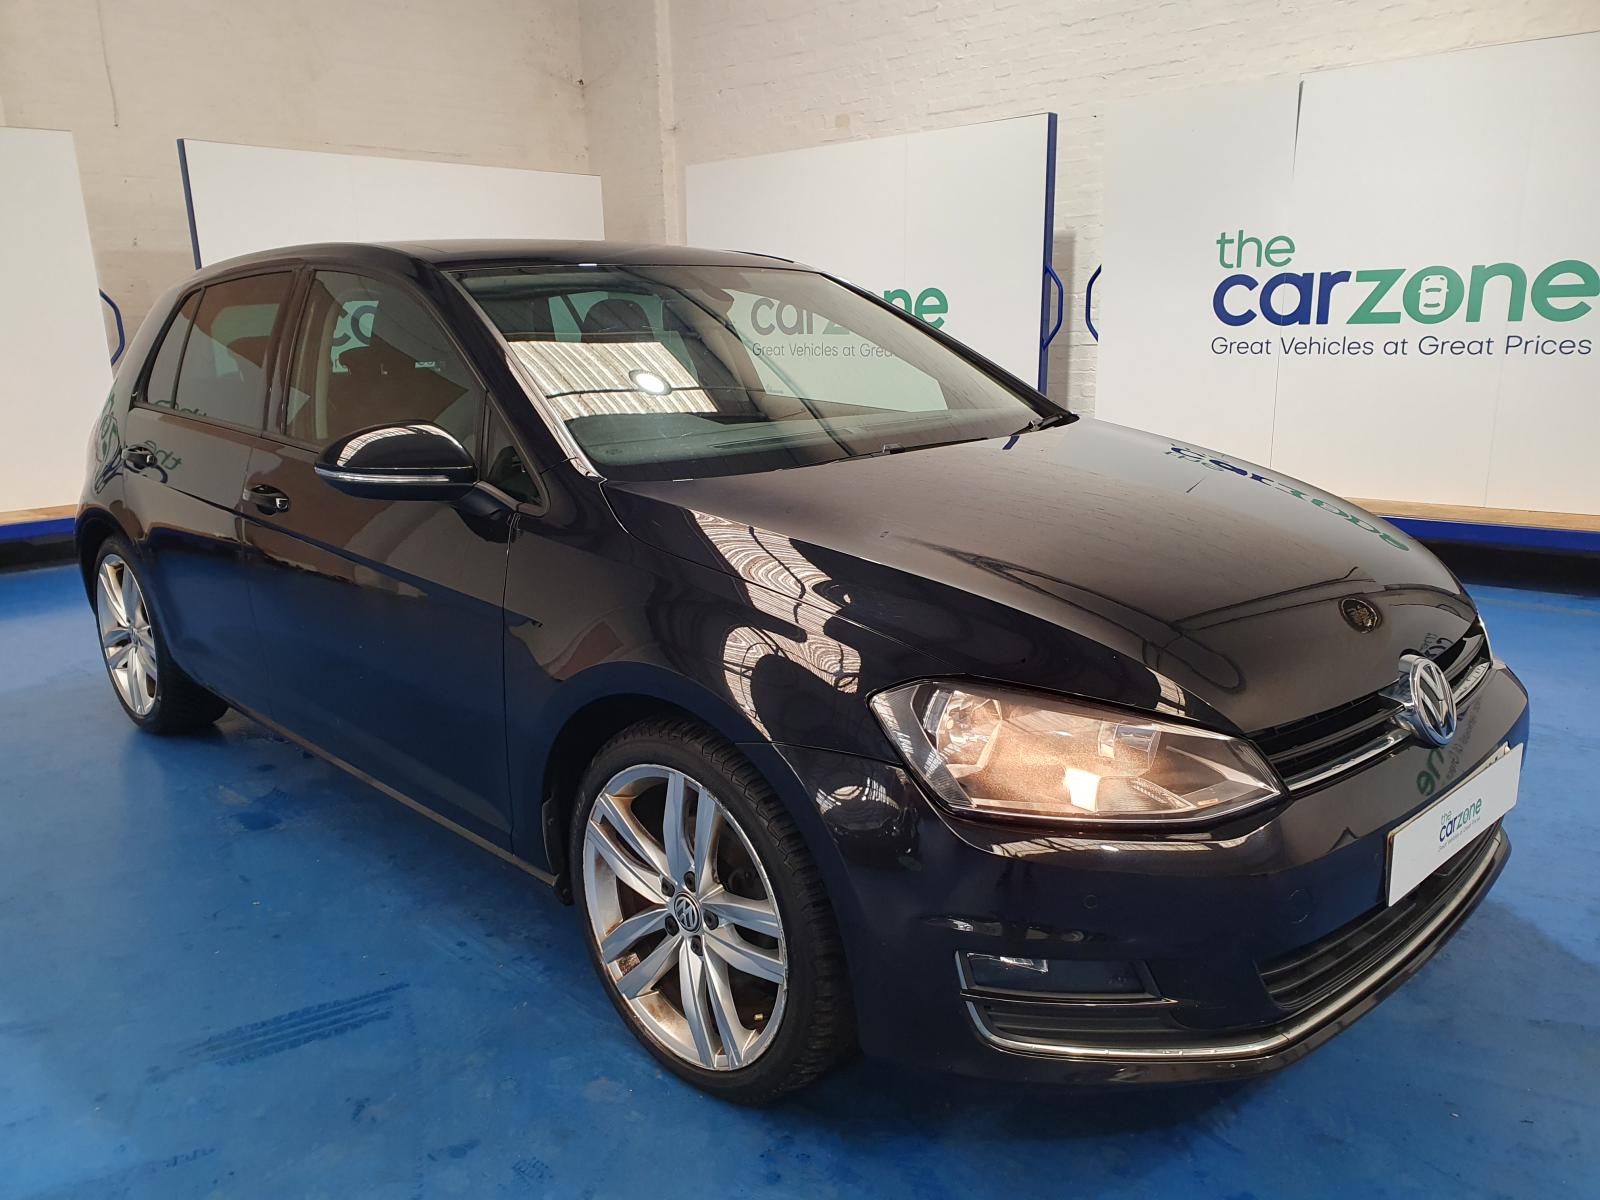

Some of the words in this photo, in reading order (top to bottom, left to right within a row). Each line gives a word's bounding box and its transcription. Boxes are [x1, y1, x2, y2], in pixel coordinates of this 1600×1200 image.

[1216, 230, 1296, 269] the
[1212, 260, 1600, 327] carzone
[752, 342, 785, 357] Great
[789, 342, 839, 358] Vehicles
[842, 344, 858, 358] at
[859, 343, 897, 359] Grea
[1211, 337, 1272, 356] Great
[1280, 336, 1375, 356] Vehicles
[1383, 337, 1408, 356] at
[1418, 335, 1495, 356] Great
[1504, 334, 1593, 356] Prices
[1439, 797, 1483, 843] carzone
